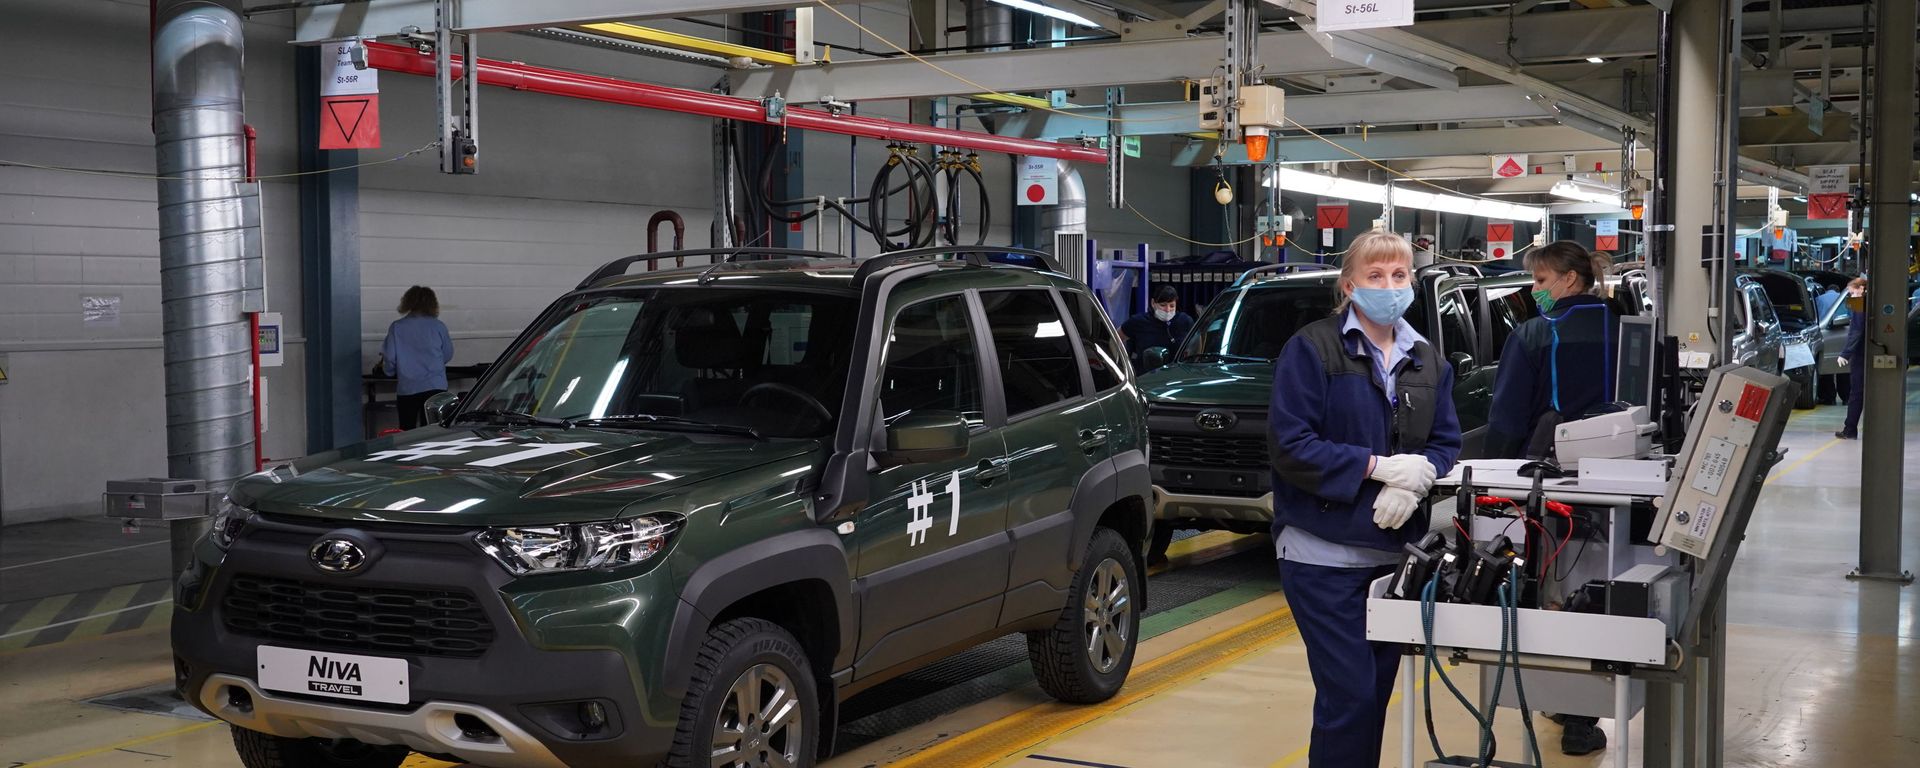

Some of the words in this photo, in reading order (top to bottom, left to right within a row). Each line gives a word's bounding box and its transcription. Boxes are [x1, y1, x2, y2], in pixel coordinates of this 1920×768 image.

[1344, 3, 1379, 15] St-56L
[337, 46, 351, 55] SLA
[363, 437, 602, 467] #1
[907, 469, 960, 547] #1
[308, 655, 362, 682] NIVA
[311, 682, 359, 695] TRAVEL
